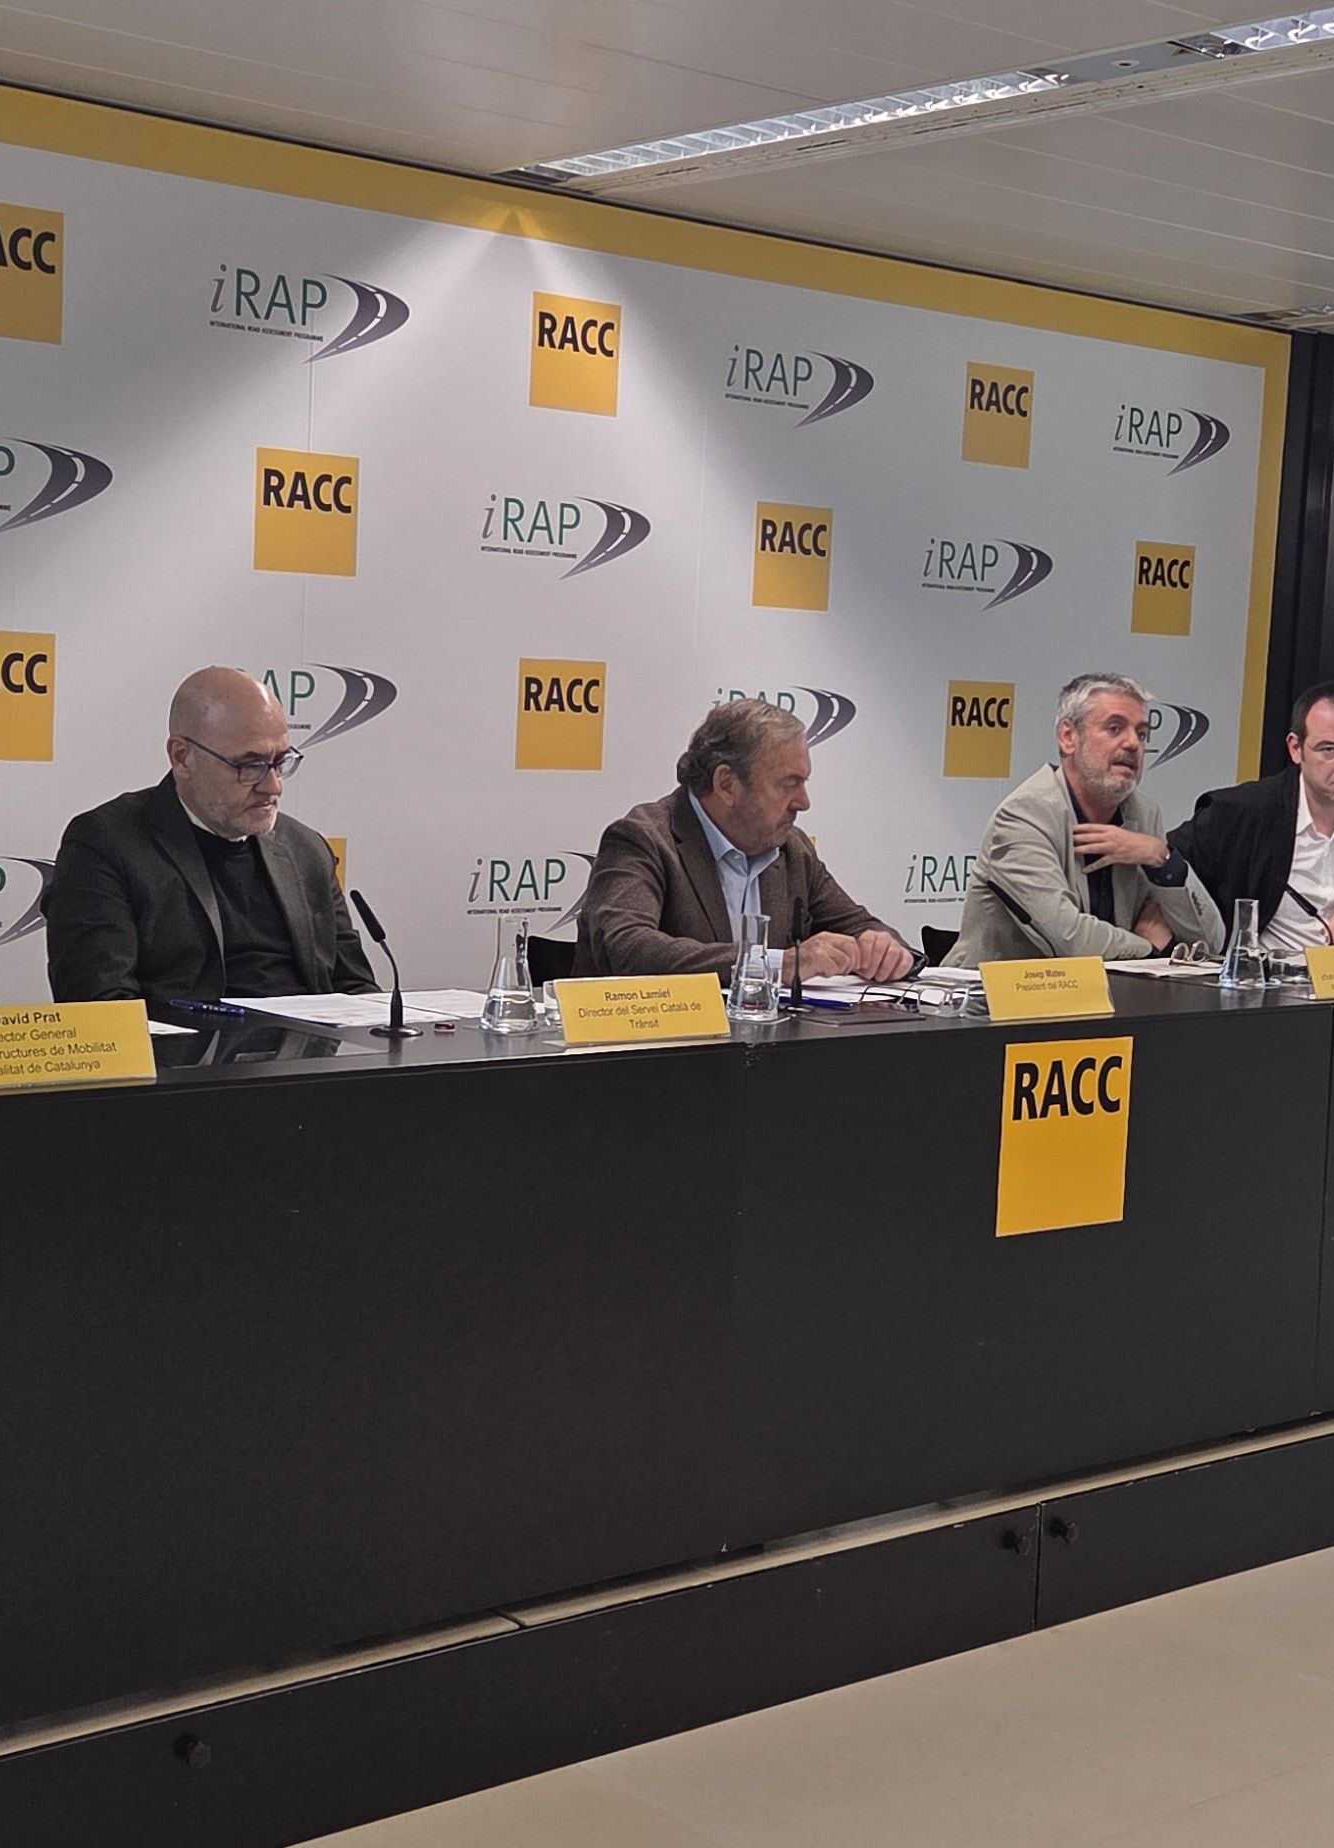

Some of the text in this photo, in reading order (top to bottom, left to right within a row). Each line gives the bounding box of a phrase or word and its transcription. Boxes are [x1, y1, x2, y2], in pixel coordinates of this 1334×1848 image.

[210, 263, 327, 326] iRAP
[537, 311, 615, 358] RACC
[726, 345, 812, 396] iRAP
[969, 378, 1029, 418] RACC
[1114, 404, 1182, 448] iRAP
[262, 467, 353, 514] RACC
[482, 494, 581, 545] iRAP
[760, 518, 828, 558] RACC
[923, 538, 998, 582] iRAP
[1138, 555, 1191, 590] RACC
[523, 676, 600, 714] RACC
[951, 695, 1010, 729] RACC
[468, 858, 566, 902] iRAP
[578, 1007, 613, 1018] Director
[616, 1005, 630, 1015] del
[631, 1004, 659, 1015] Servei
[690, 1002, 702, 1011] de
[605, 991, 638, 1001] Ramon
[30, 1027, 77, 1041] General
[33, 1012, 61, 1024] Prat
[28, 1062, 42, 1073] de
[45, 1059, 101, 1073] Catalunya
[50, 1045, 65, 1055] de
[68, 1042, 117, 1055] Mobilitat
[1012, 1055, 1123, 1121] RACC
